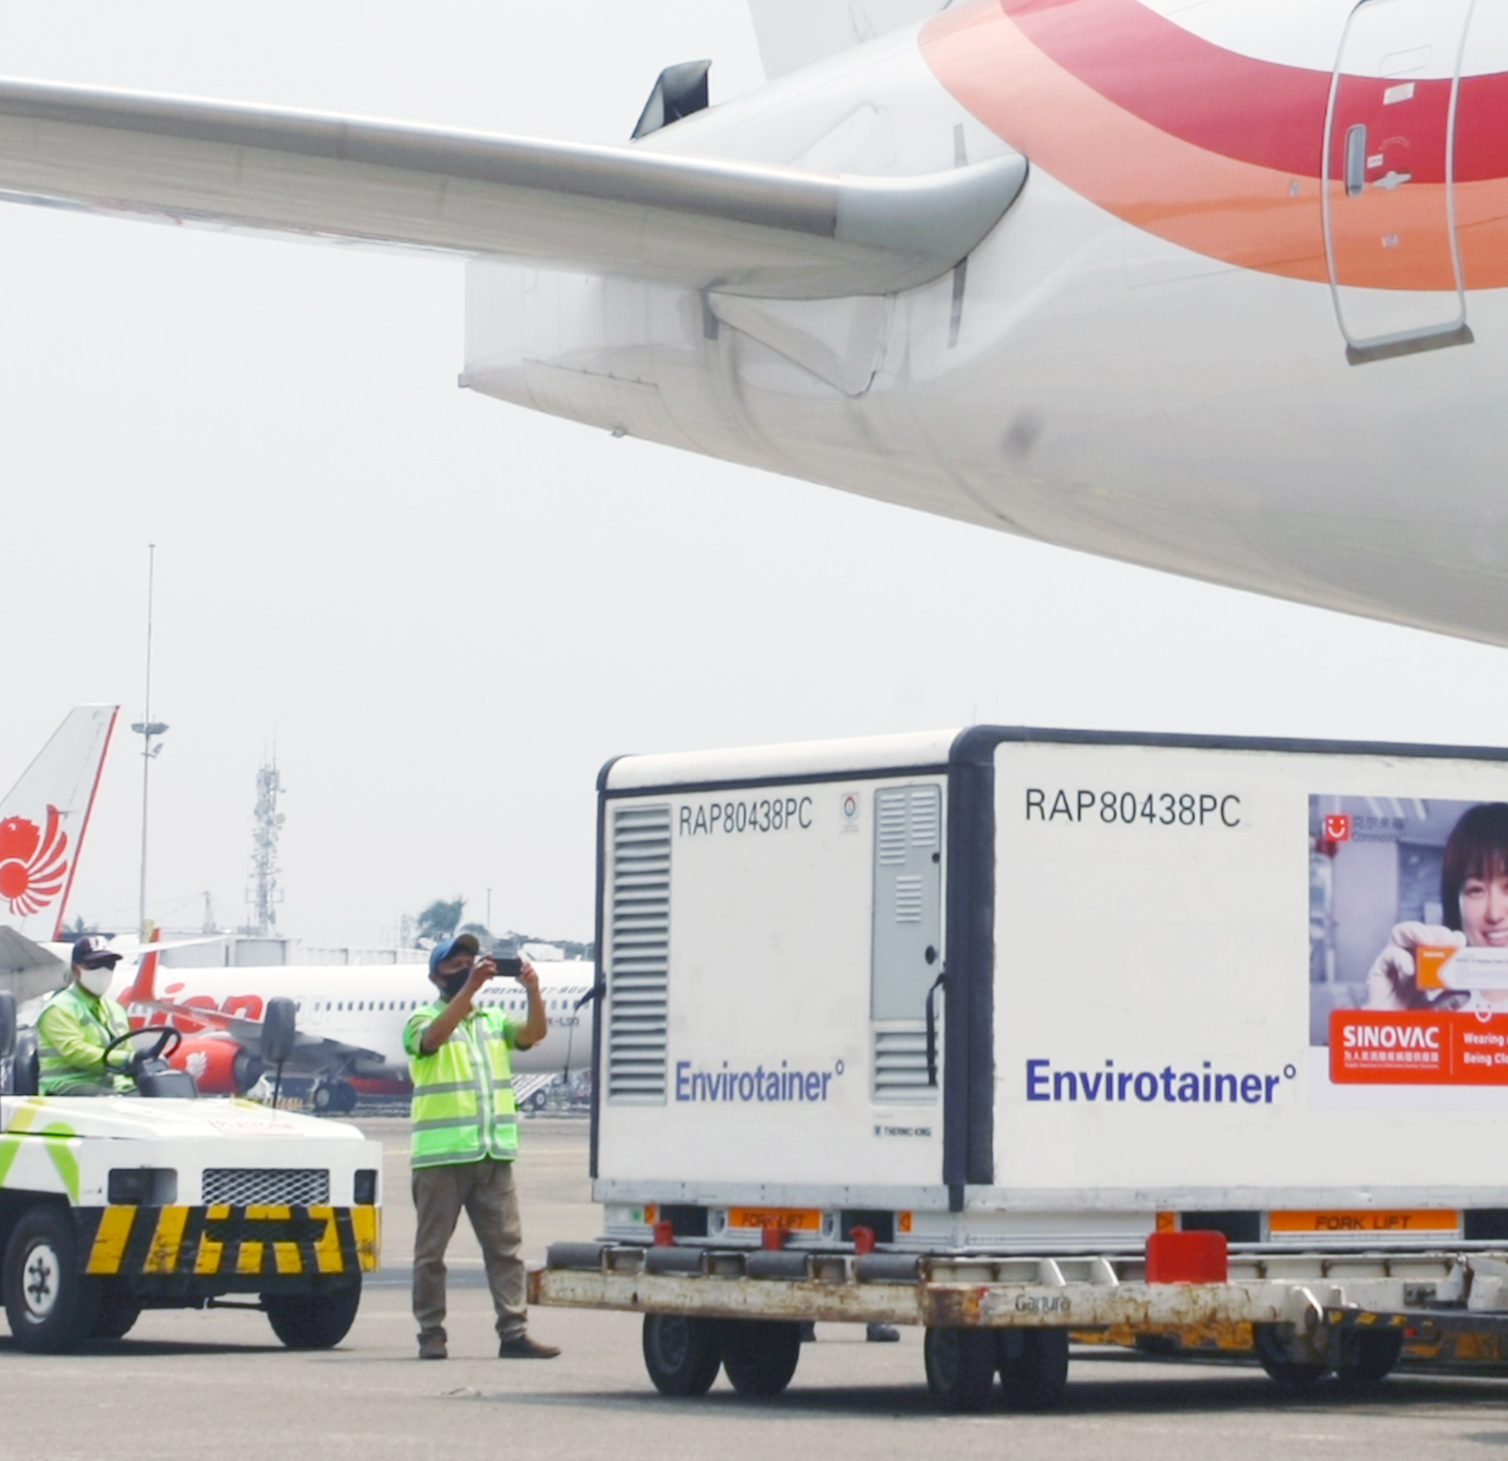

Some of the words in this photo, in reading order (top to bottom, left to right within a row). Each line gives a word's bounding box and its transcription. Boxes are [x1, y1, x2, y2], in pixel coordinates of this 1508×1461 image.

[679, 796, 813, 837] RAP80438PC
[1025, 787, 1242, 828] RAP80438PC
[1343, 1025, 1439, 1049] SINOVAC
[1463, 1032, 1505, 1047] Wearing
[1463, 1052, 1493, 1067] Being
[1314, 1215, 1365, 1230] FORK
[1372, 1215, 1413, 1230] LIFT
